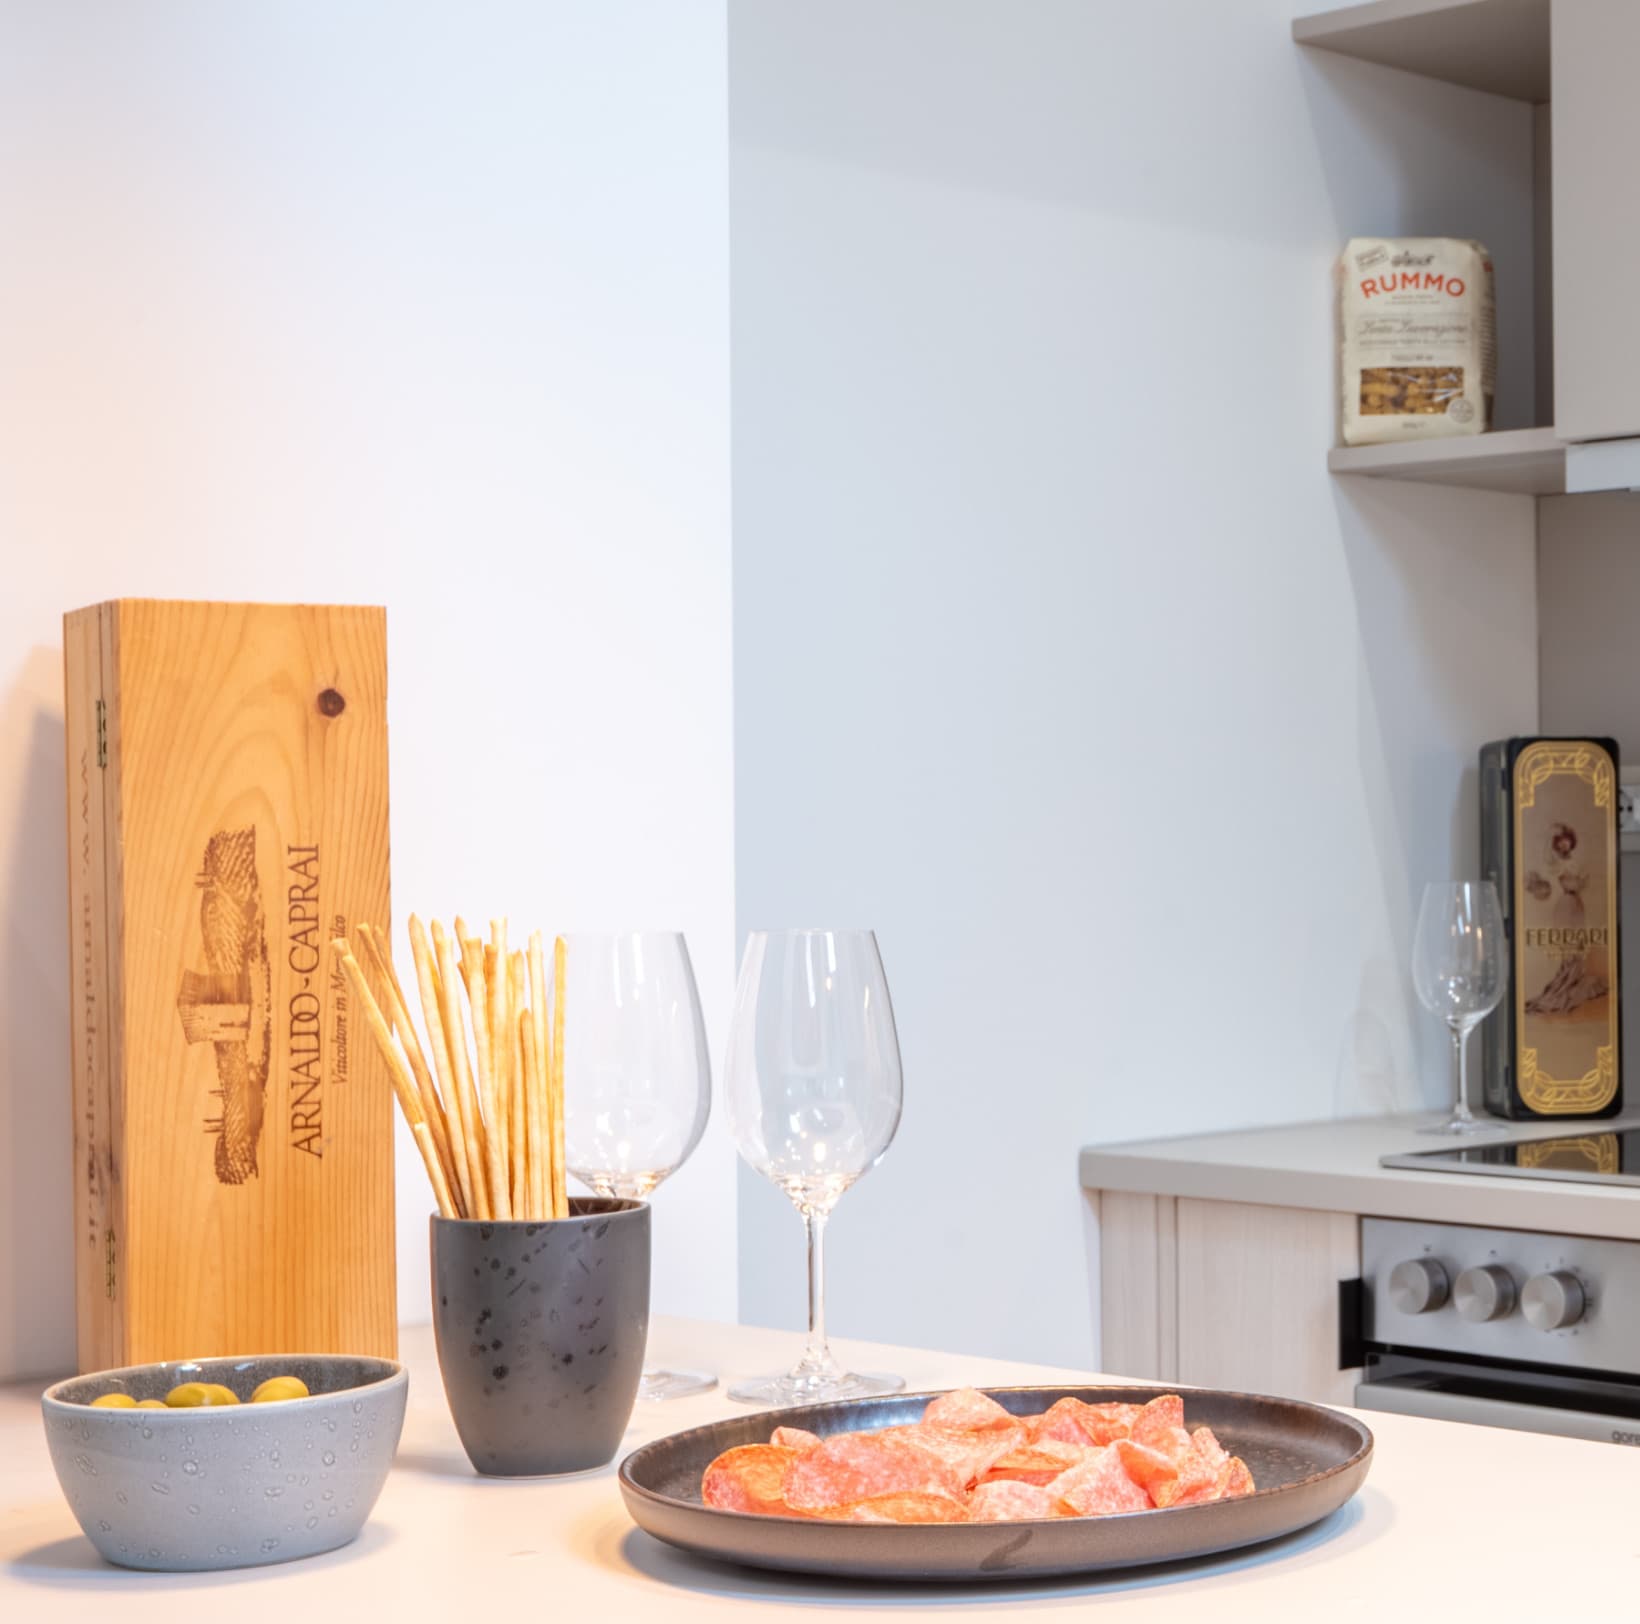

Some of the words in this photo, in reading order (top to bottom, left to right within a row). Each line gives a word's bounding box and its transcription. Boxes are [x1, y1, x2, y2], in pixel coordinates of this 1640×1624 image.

[1360, 271, 1466, 299] RUMMO
[1526, 928, 1608, 947] FERRARI
[332, 996, 346, 1012] in
[330, 1015, 348, 1085] Viticoltore
